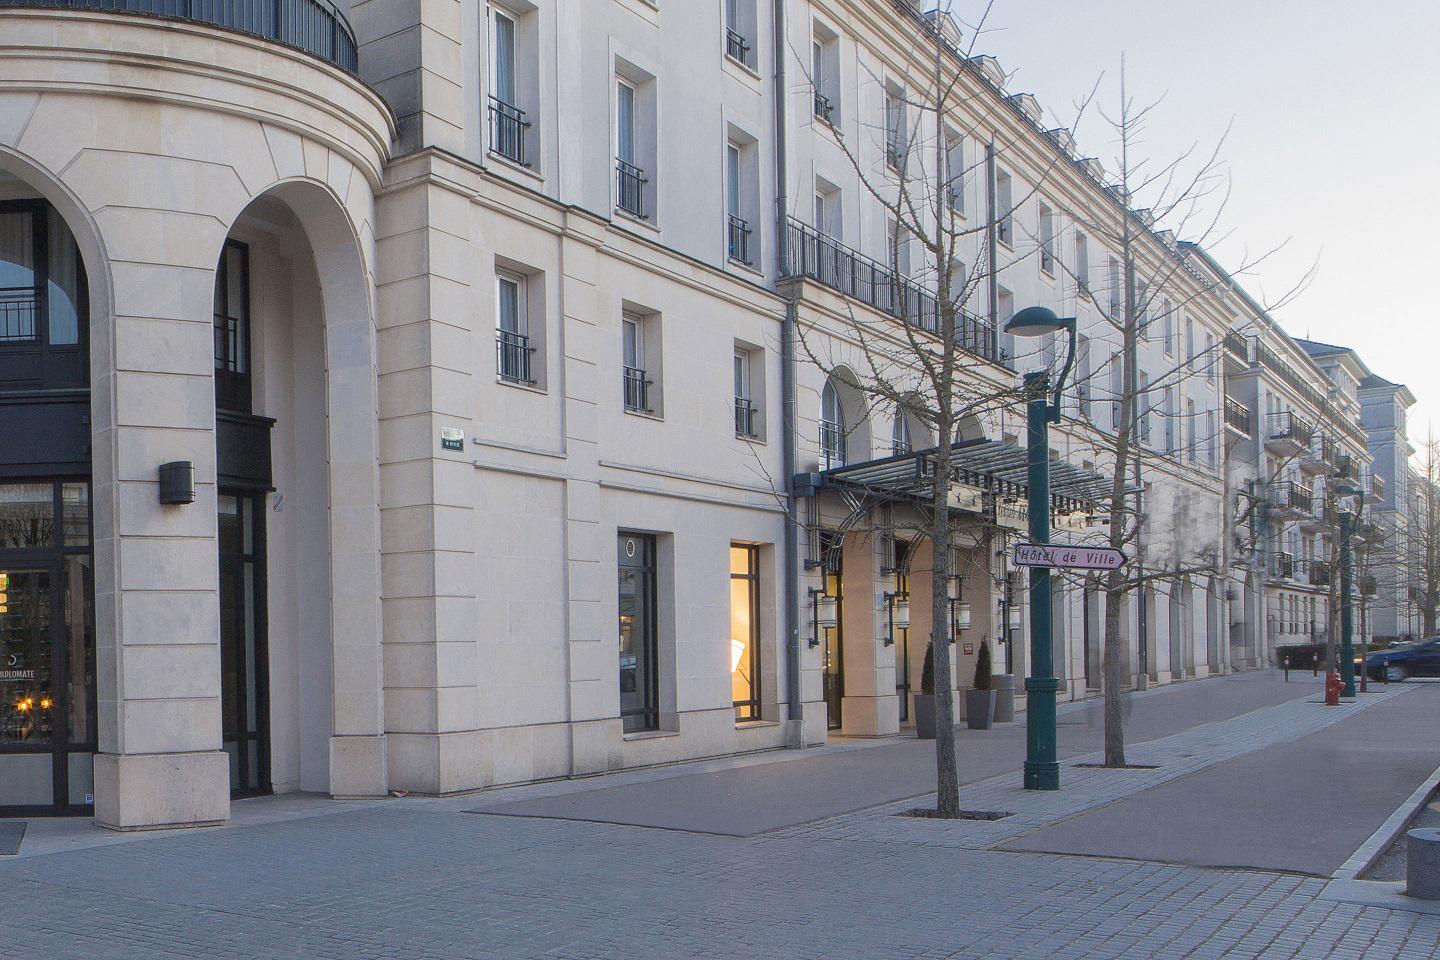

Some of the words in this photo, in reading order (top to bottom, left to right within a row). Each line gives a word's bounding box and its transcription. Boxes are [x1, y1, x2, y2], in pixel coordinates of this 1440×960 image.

[1020, 549, 1055, 562] Hôtel
[1062, 552, 1077, 563] de
[1087, 552, 1116, 565] Ville
